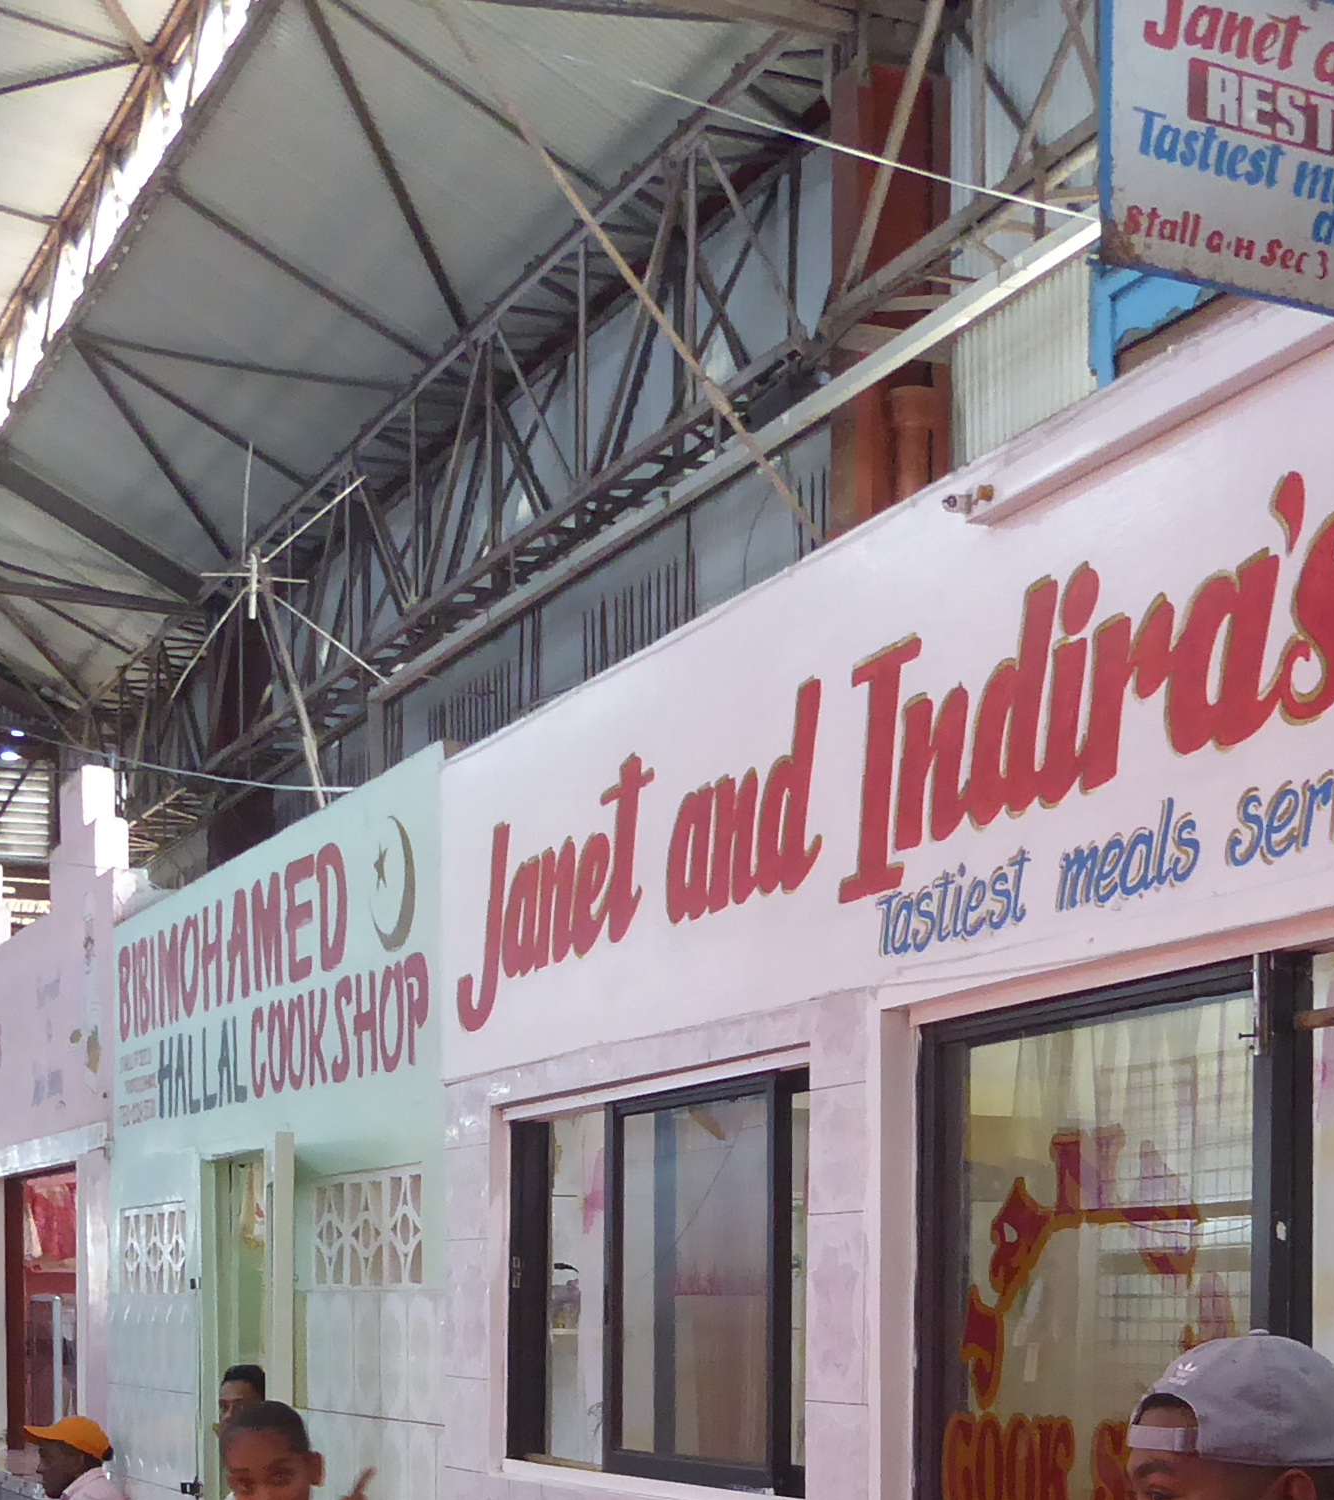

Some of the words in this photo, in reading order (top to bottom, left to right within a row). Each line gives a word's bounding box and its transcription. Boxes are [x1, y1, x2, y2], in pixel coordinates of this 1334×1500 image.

[1143, 0, 1311, 70] Janet
[1132, 106, 1286, 188] Tastiest
[1123, 204, 1202, 248] Stall
[456, 752, 655, 1033] Janet
[665, 677, 823, 925] and
[877, 846, 1032, 957] Tastiest
[1055, 797, 1201, 914] meals
[157, 1015, 248, 1120] HALLAL
